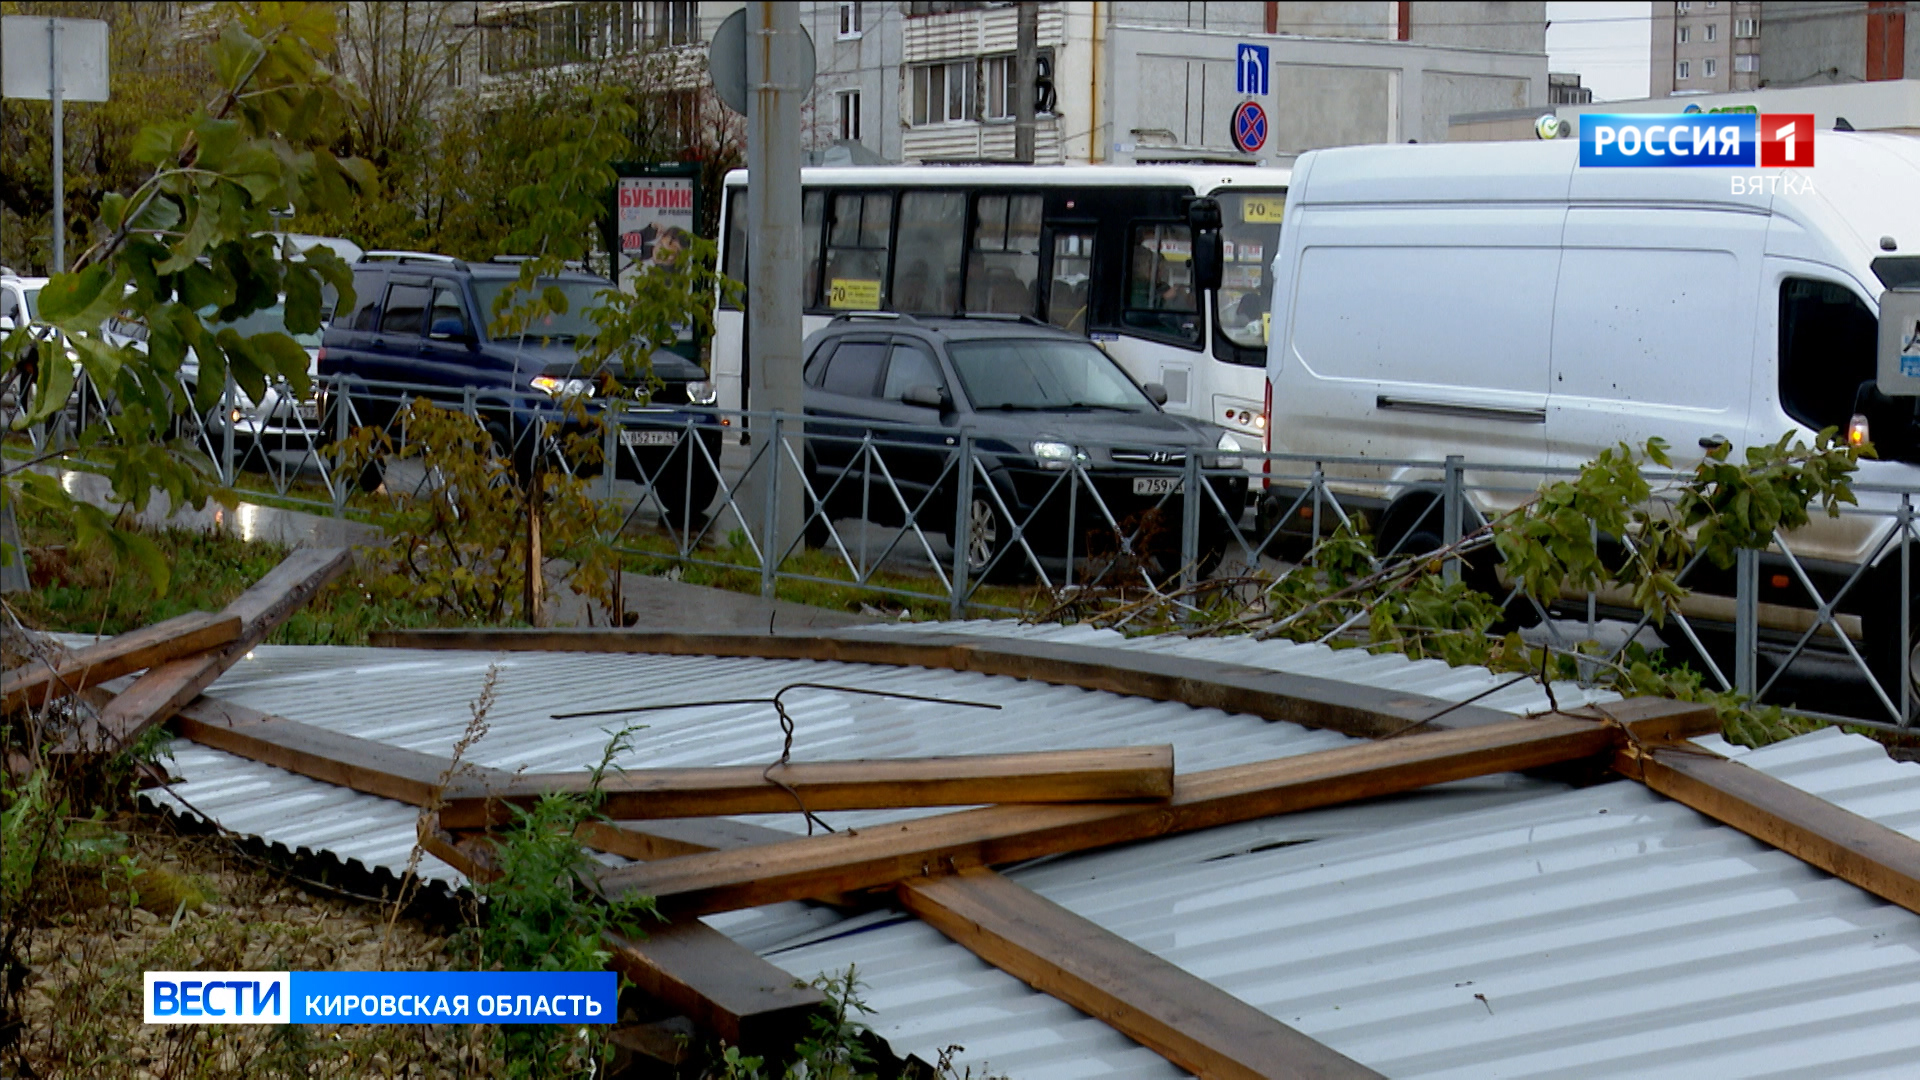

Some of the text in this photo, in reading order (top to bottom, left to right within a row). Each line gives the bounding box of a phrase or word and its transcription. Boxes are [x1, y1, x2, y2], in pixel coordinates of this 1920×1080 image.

[620, 188, 692, 208] БУБЛИК
[1247, 203, 1265, 216] 70
[833, 286, 845, 302] 70
